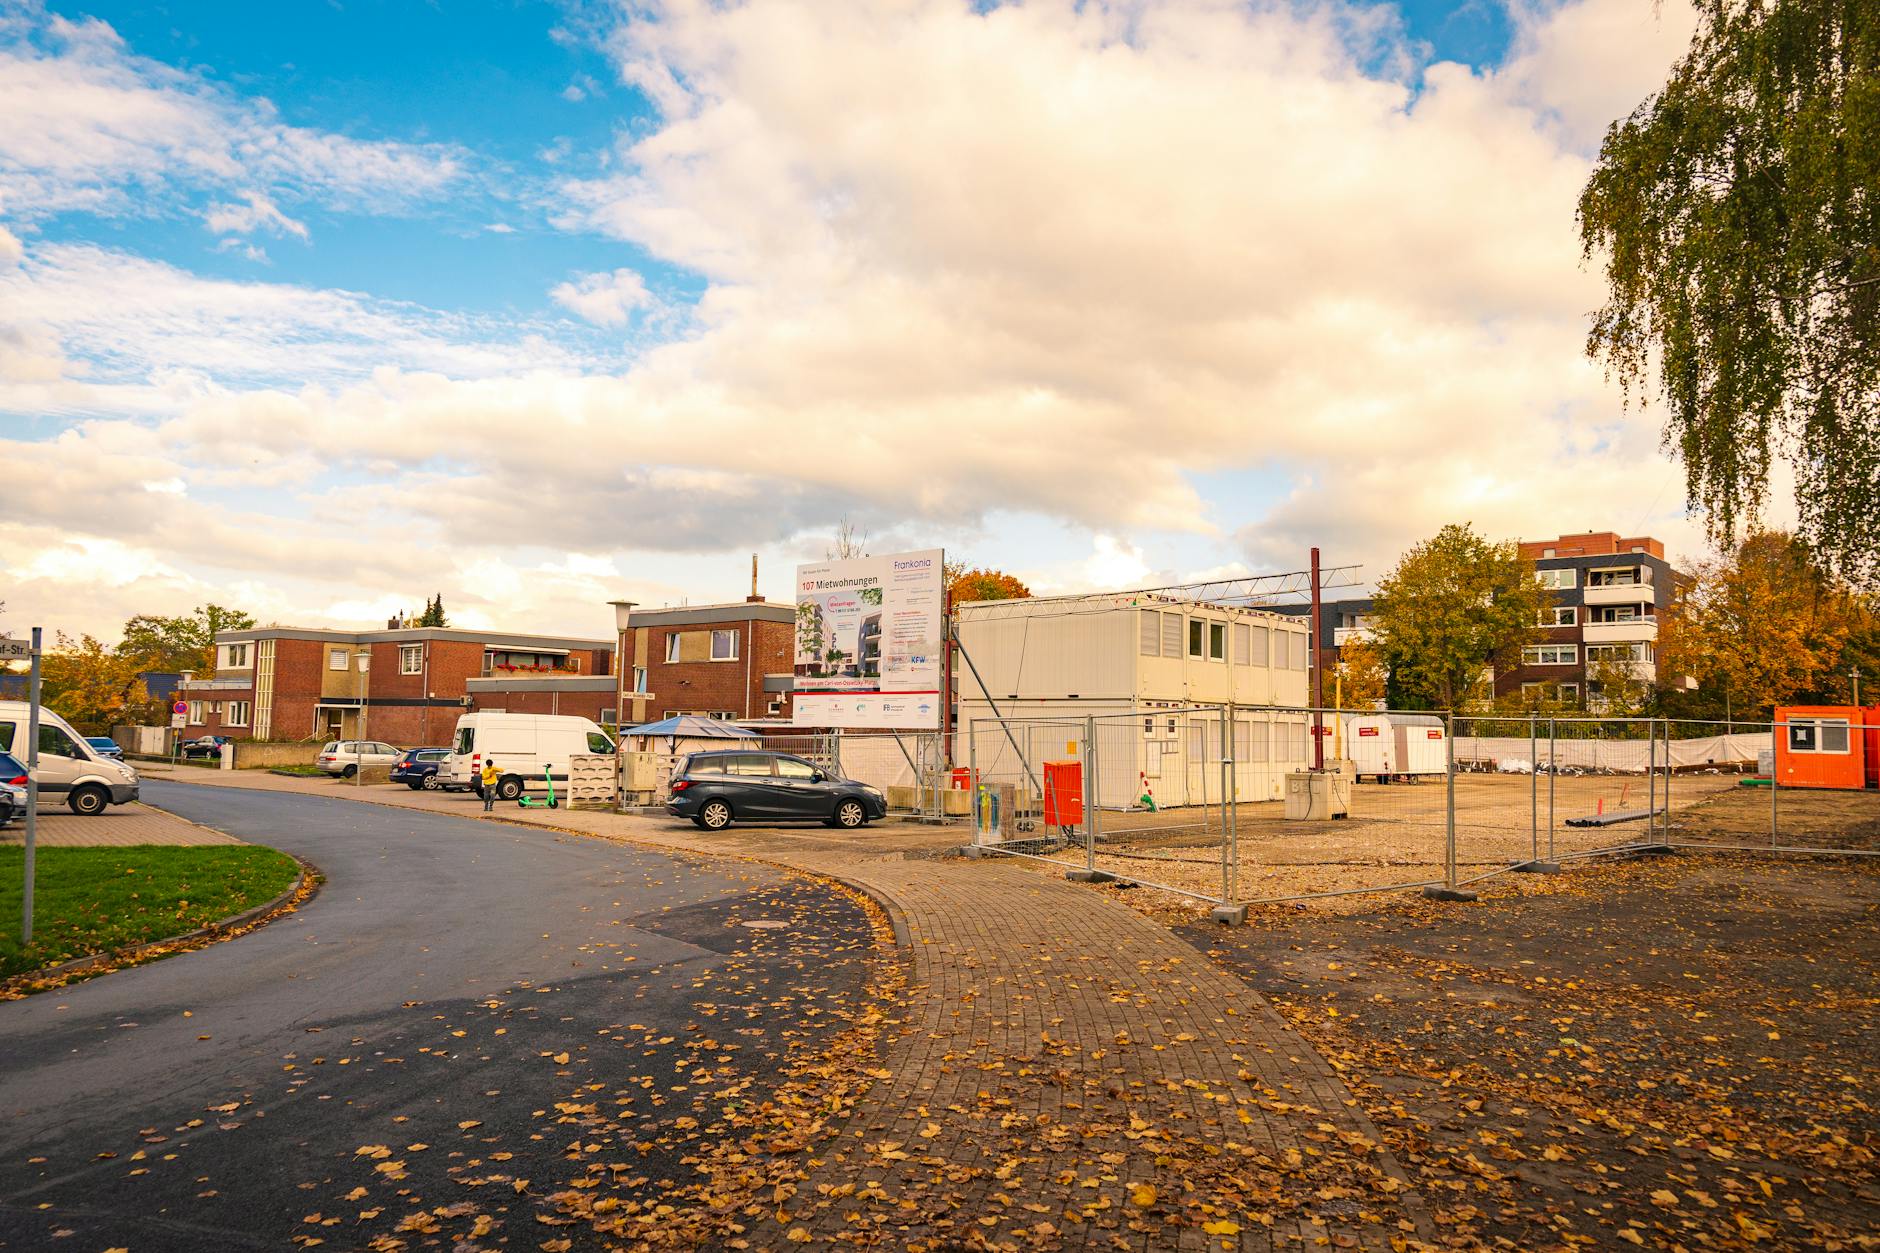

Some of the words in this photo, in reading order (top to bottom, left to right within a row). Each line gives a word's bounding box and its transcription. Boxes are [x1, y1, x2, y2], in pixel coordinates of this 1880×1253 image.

[894, 560, 931, 570] Frankonia
[802, 581, 815, 591] 107
[816, 577, 878, 590] Mietwohnungen
